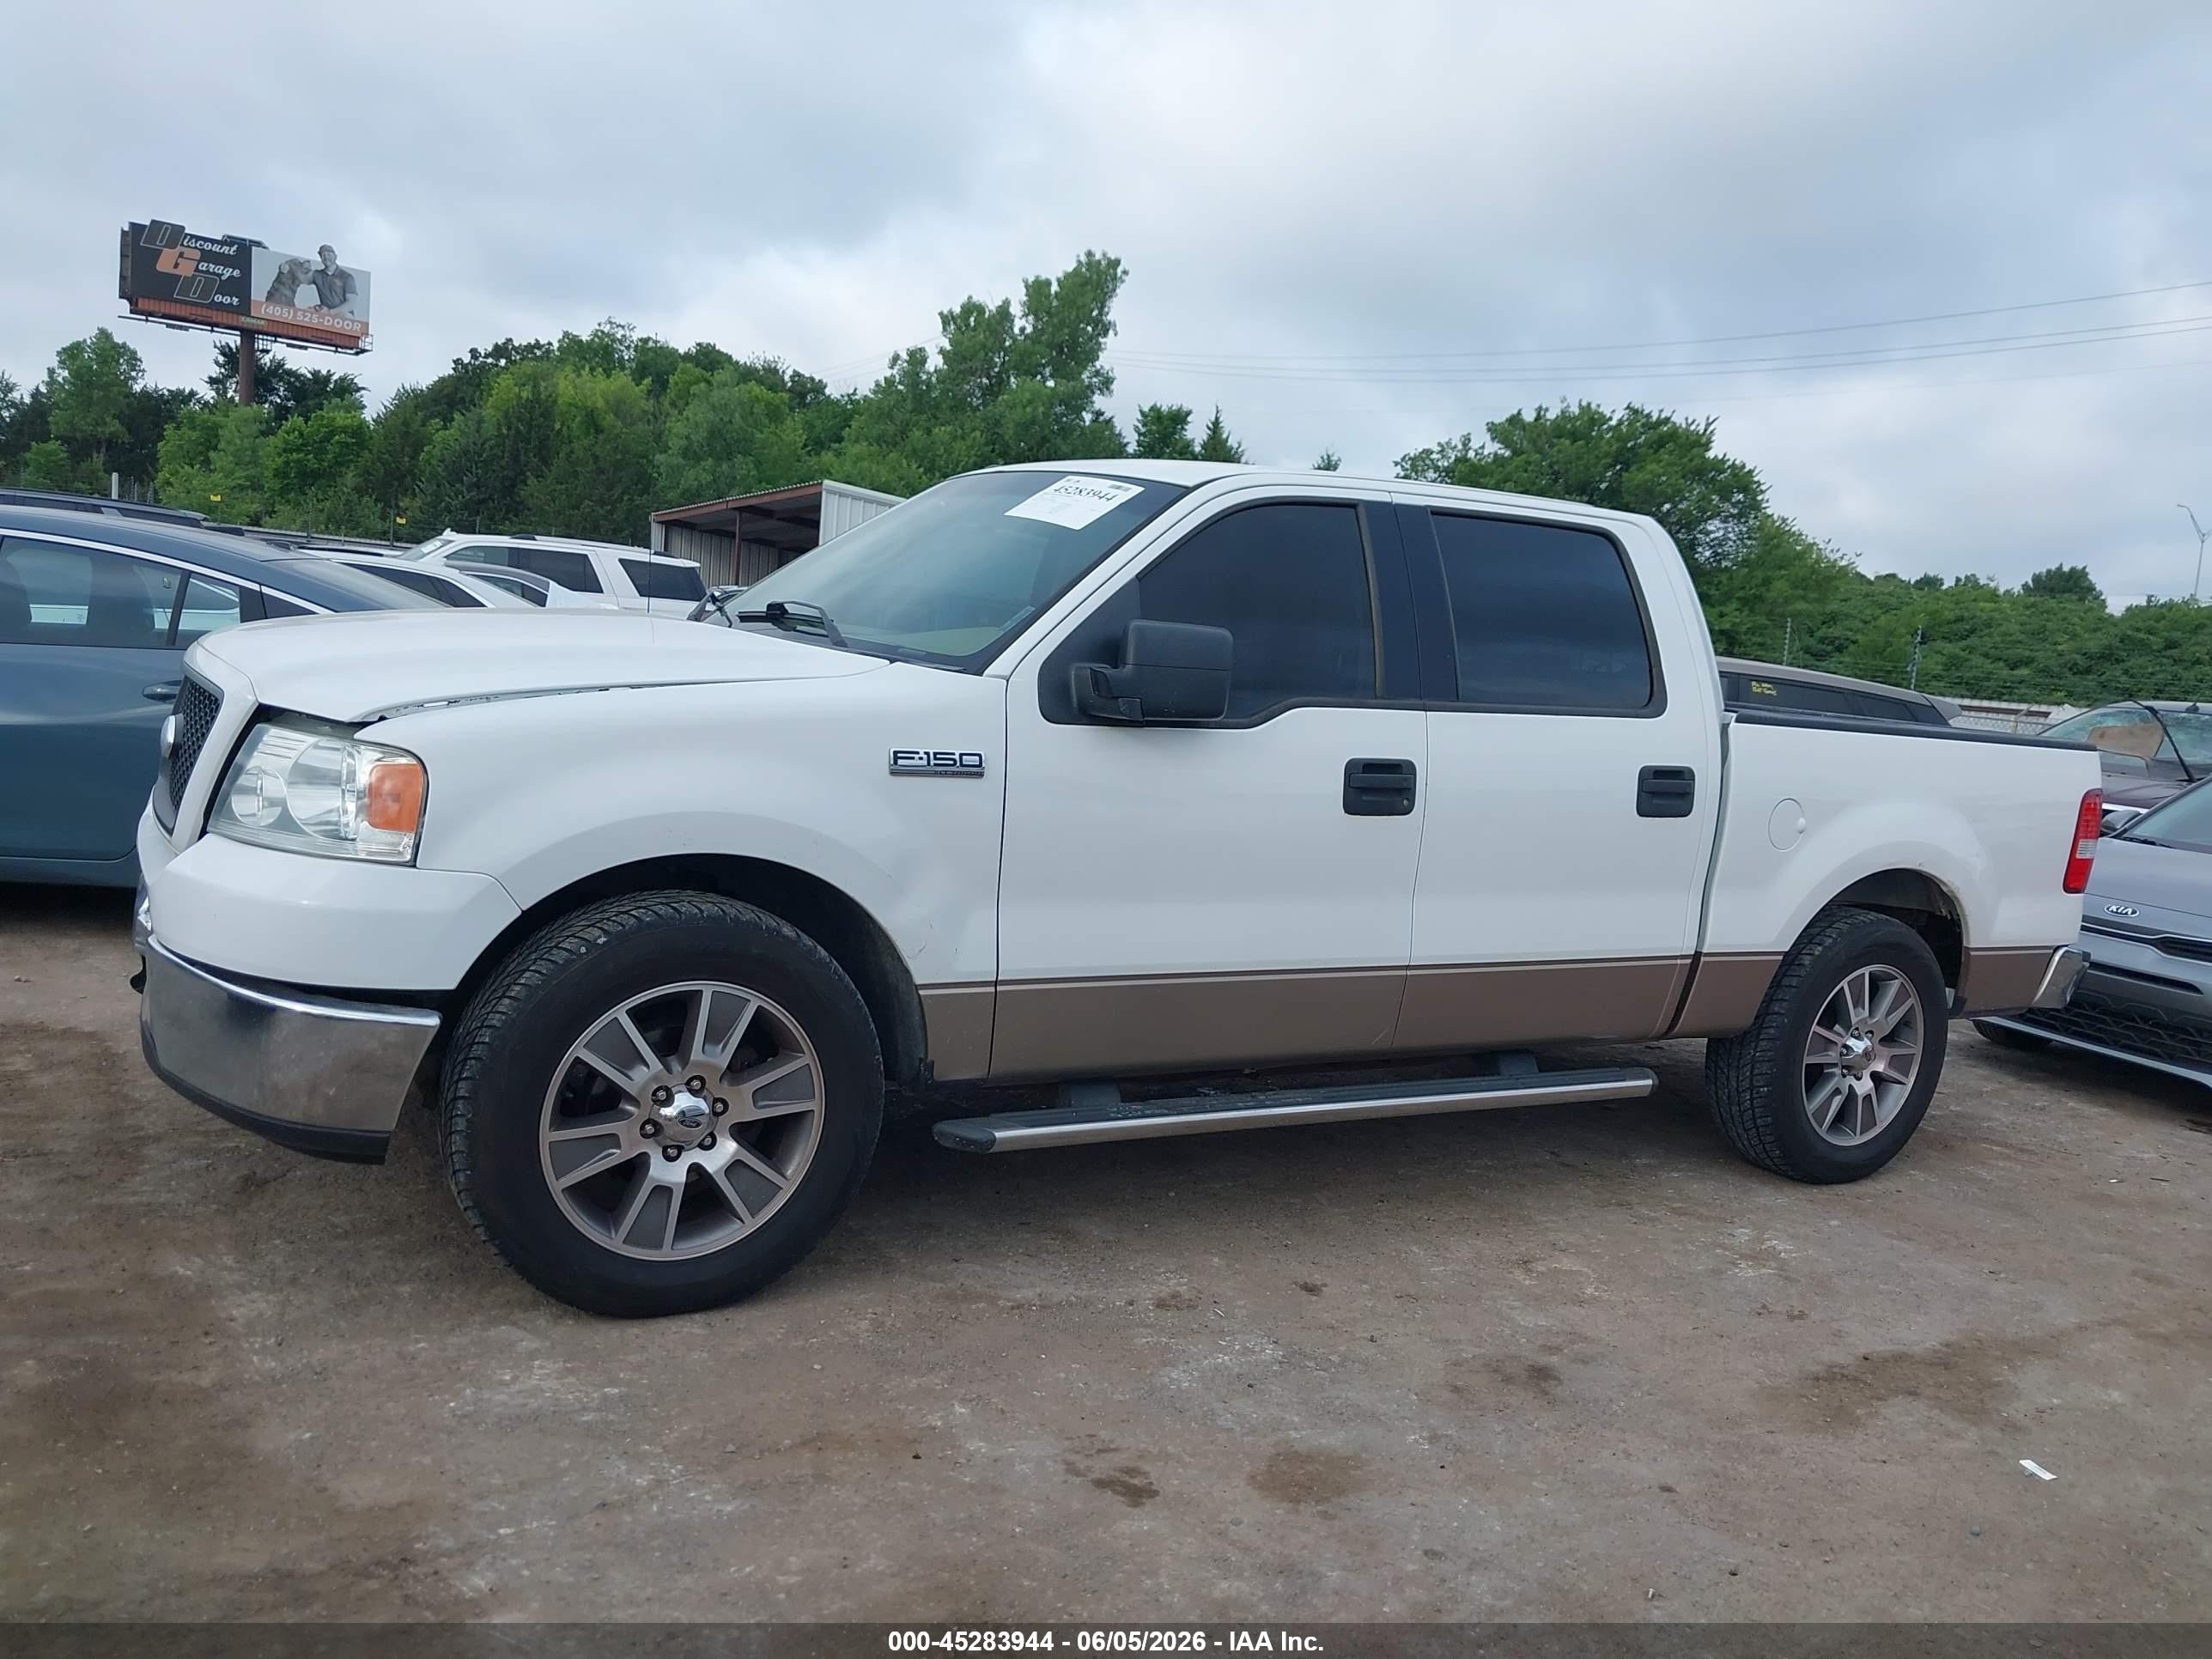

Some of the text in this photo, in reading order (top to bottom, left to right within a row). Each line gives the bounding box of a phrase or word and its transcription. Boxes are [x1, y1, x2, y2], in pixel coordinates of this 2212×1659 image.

[140, 219, 239, 255] Discount
[156, 246, 240, 280] Garage
[173, 272, 240, 306] Door
[261, 304, 294, 320] (405)
[296, 312, 362, 331] 525-DOOR
